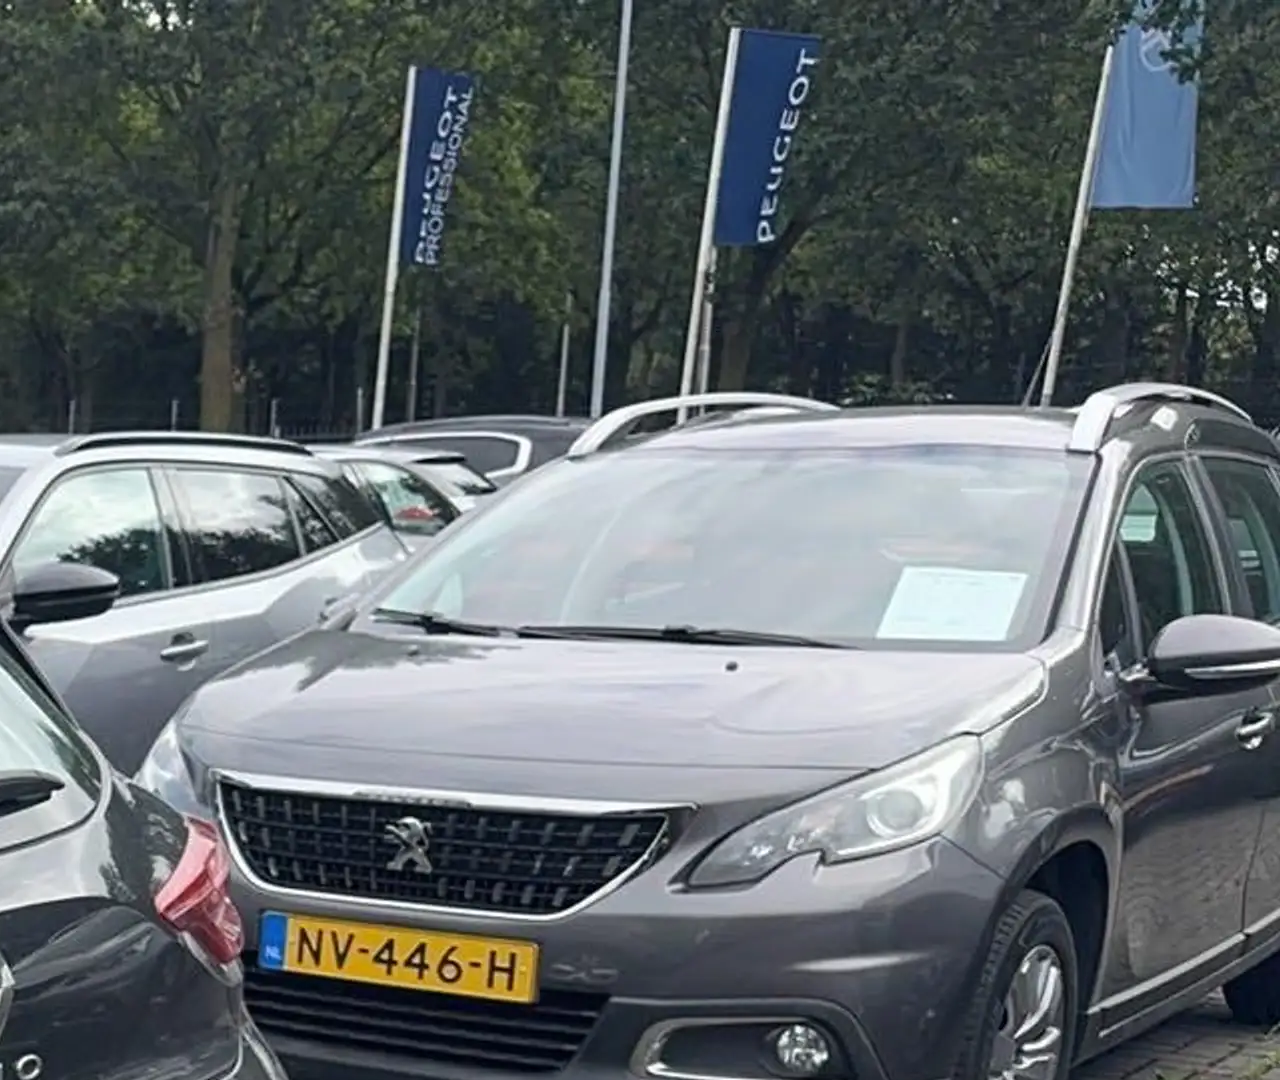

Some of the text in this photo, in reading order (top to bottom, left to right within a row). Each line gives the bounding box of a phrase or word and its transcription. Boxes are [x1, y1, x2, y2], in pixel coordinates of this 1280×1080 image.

[425, 87, 474, 265] PROFESSIONAL
[757, 48, 818, 243] PEUGEOT
[297, 927, 517, 991] NV-446-H
